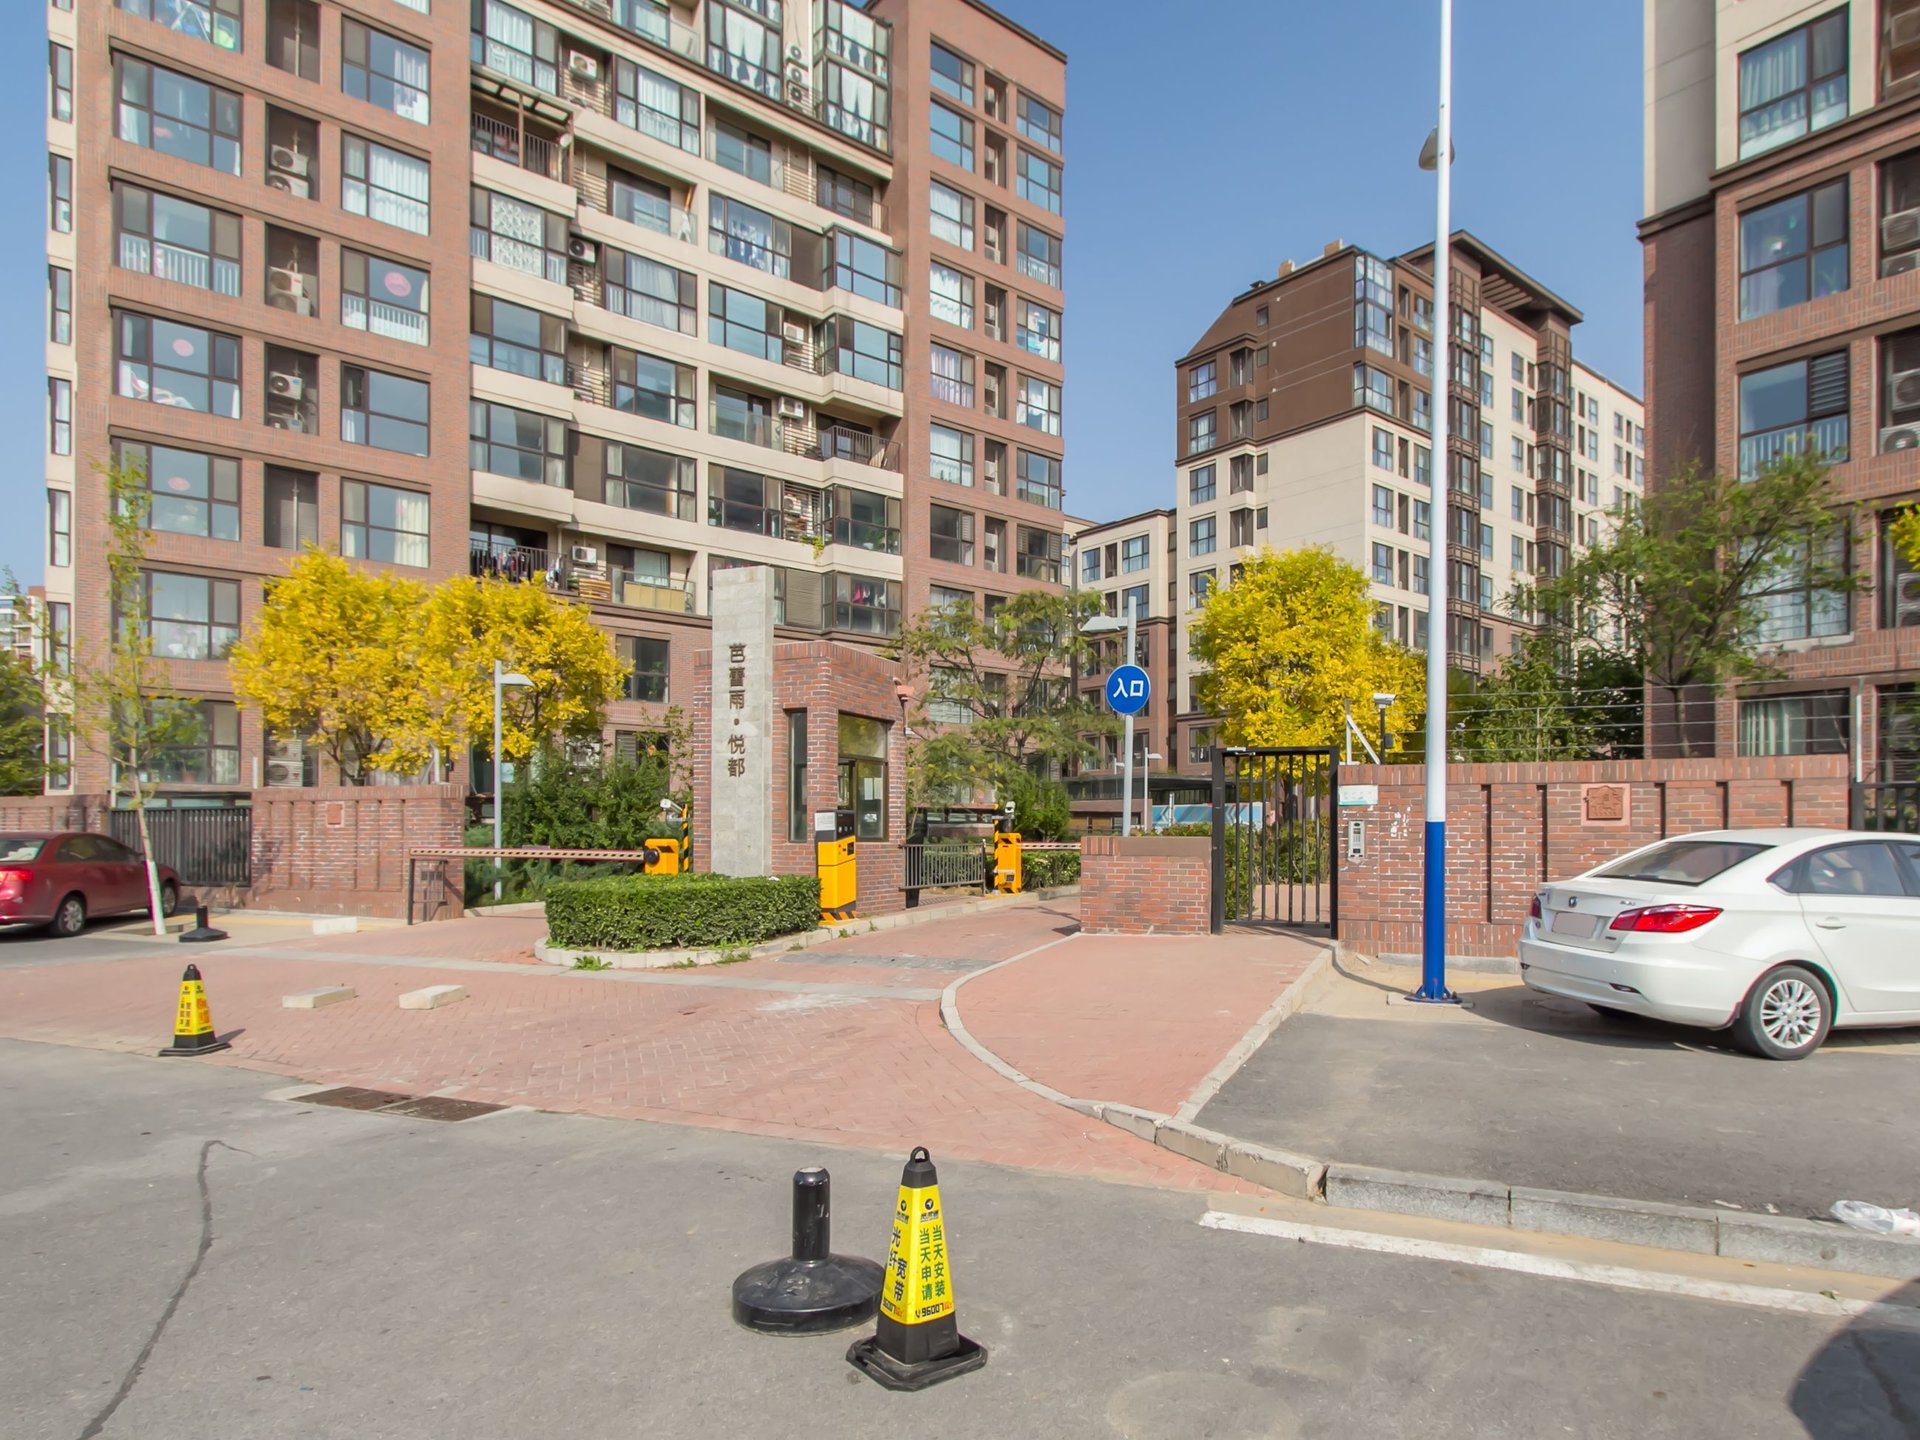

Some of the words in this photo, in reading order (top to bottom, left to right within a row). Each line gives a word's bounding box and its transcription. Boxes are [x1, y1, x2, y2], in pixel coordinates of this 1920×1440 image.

[1112, 677, 1144, 698] 入口
[889, 1226, 901, 1269] 光纤
[920, 1228, 932, 1300] 当天申请
[933, 1225, 944, 1296] 当天安装
[894, 1258, 907, 1300] 宽带
